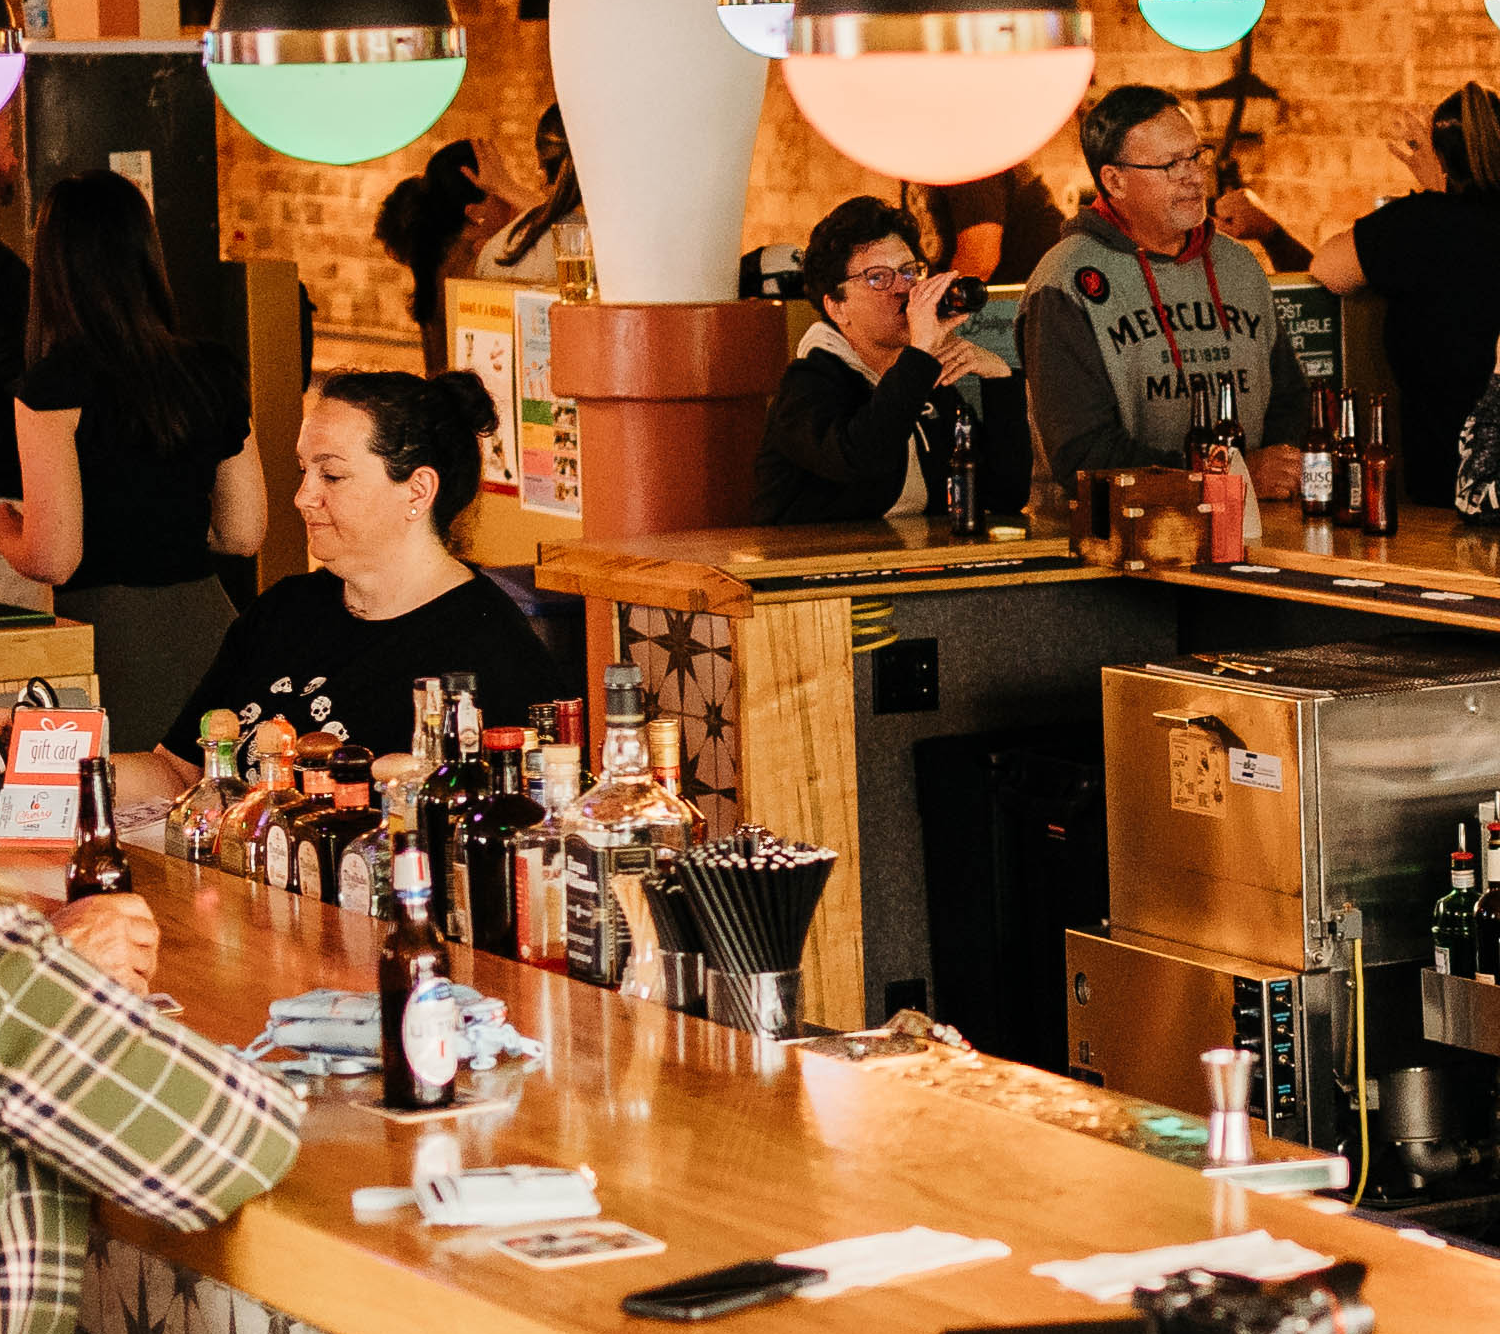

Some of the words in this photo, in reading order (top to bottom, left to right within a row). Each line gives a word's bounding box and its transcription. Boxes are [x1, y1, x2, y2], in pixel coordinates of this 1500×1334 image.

[1107, 301, 1261, 355] MERCURY
[1160, 347, 1197, 365] SCE
[30, 738, 51, 764] gift
[54, 738, 78, 761] card
